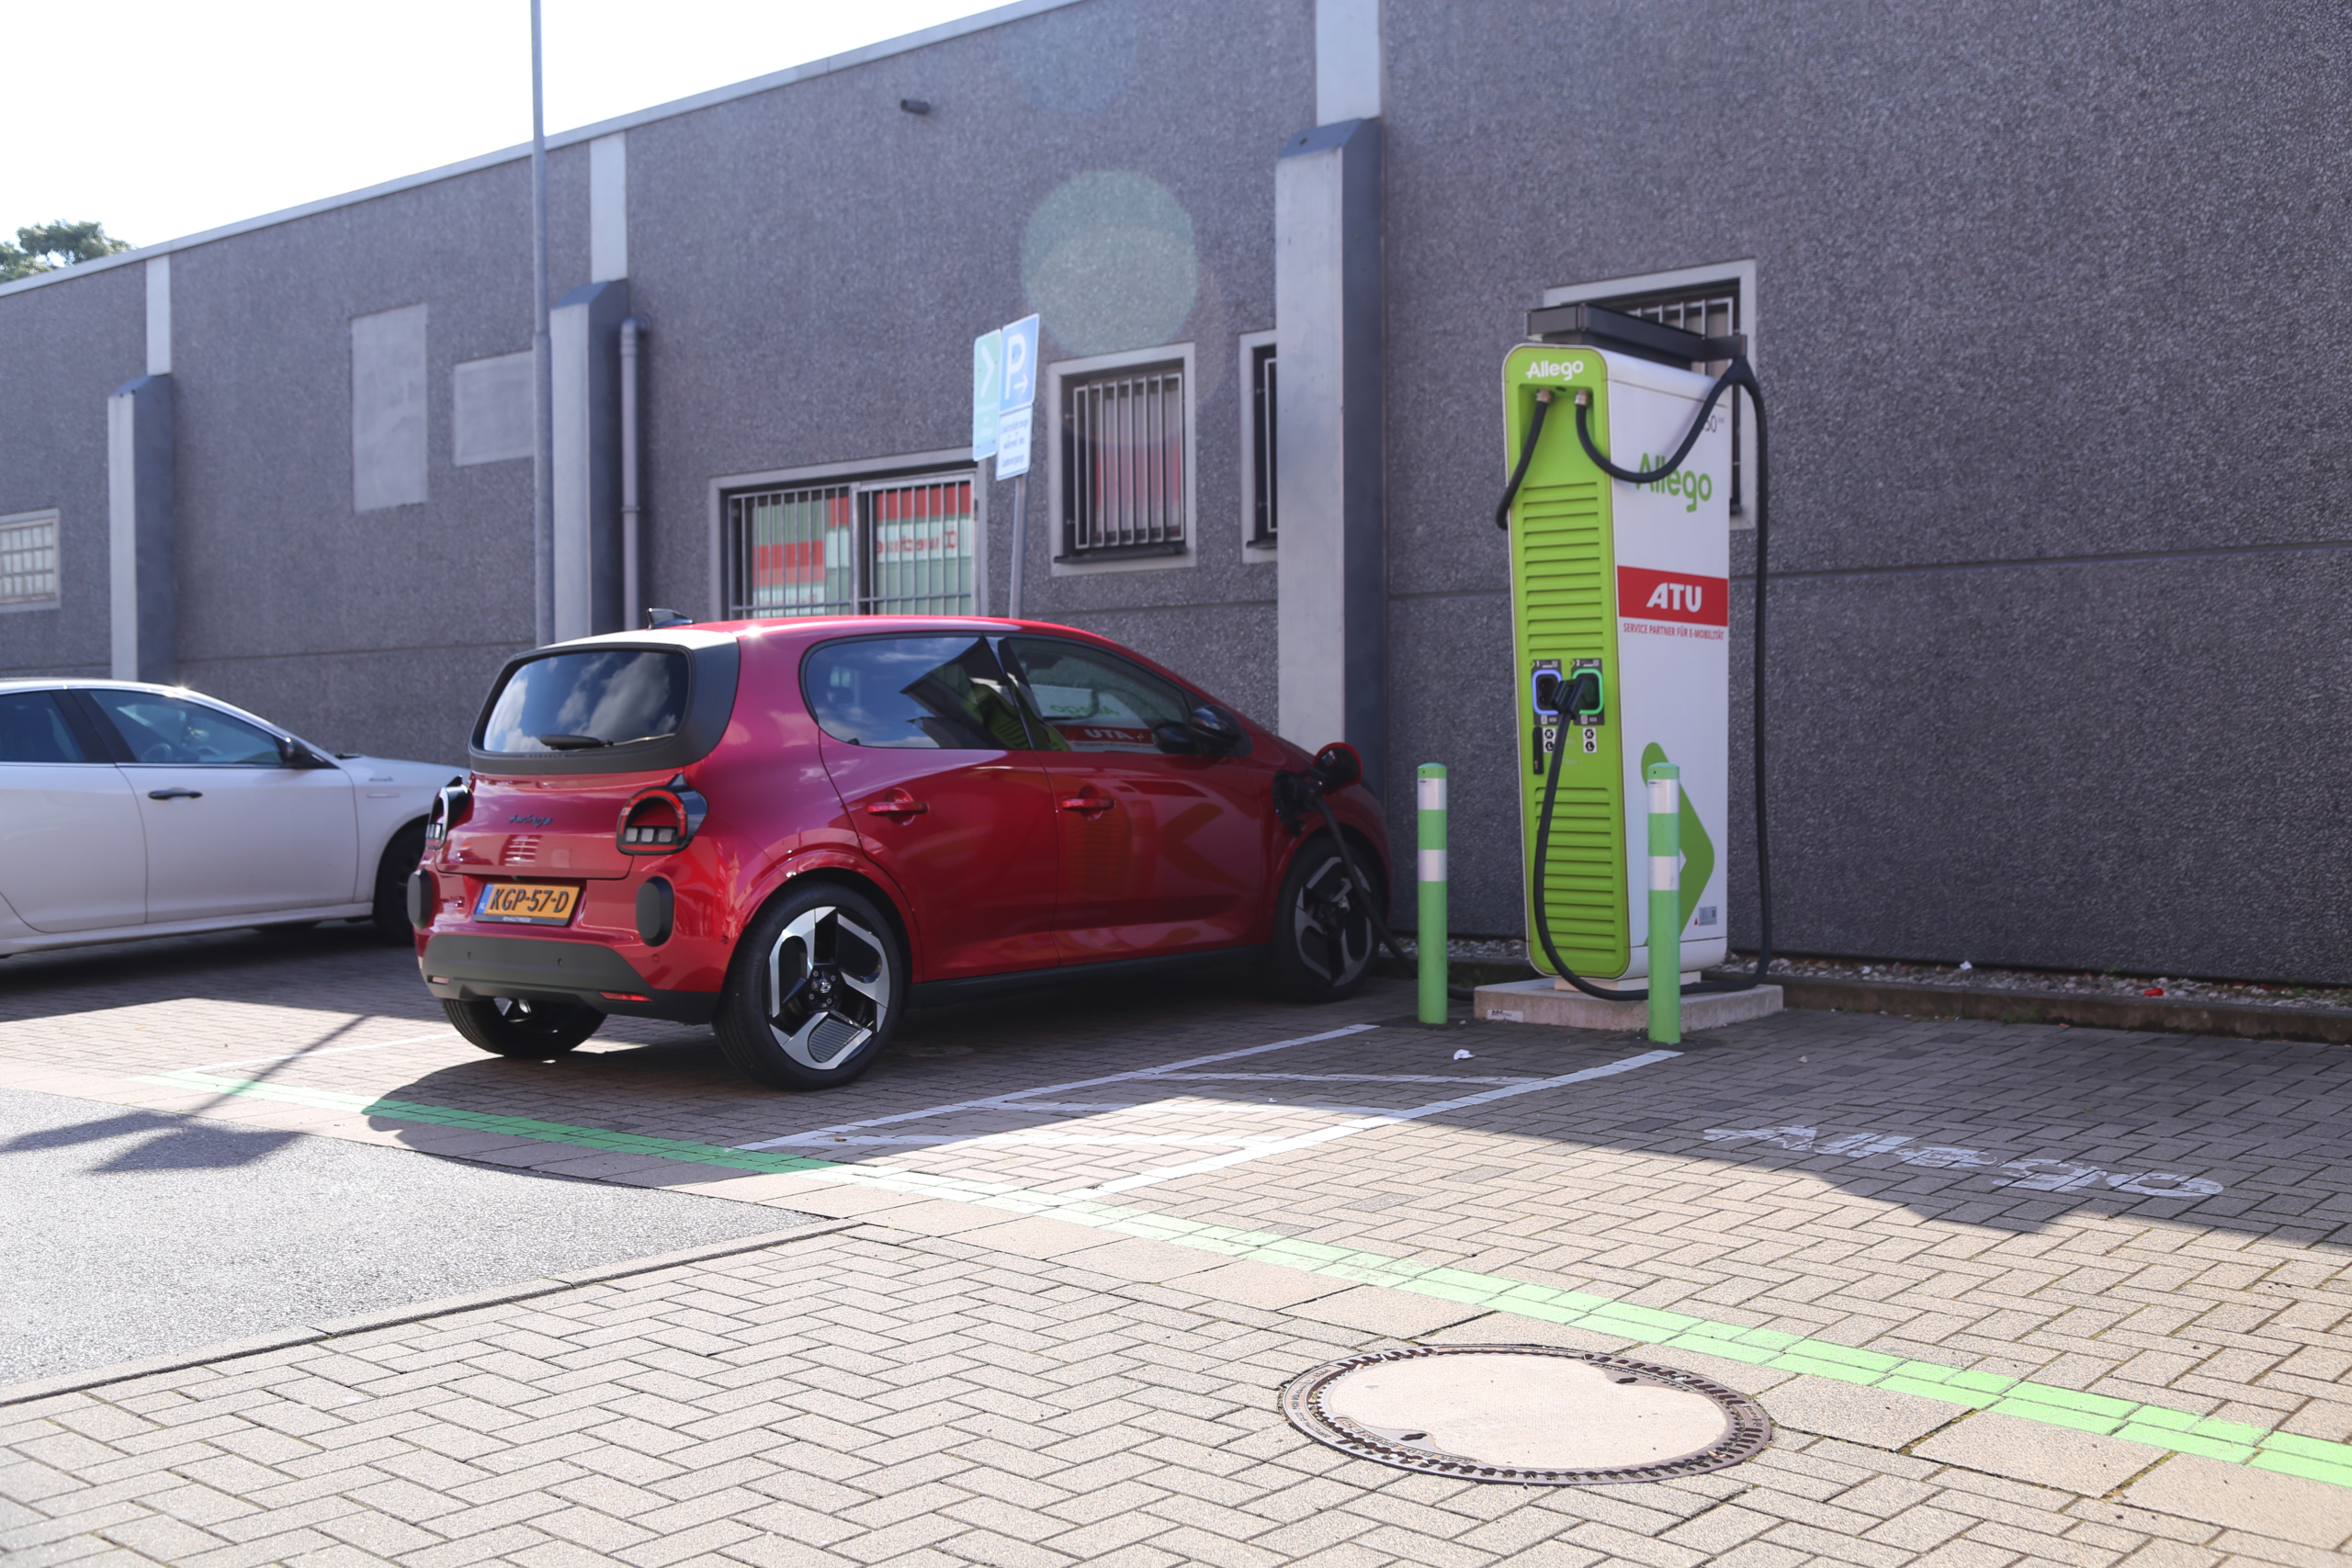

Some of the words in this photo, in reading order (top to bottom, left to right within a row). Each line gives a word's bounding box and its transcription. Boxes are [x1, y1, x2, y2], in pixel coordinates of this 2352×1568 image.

[1004, 333, 1026, 400] P
[1526, 360, 1584, 381] Allego
[1636, 452, 1713, 513] Allego
[1645, 582, 1702, 613] ATU
[1623, 623, 1647, 635] SERVICE
[1649, 625, 1675, 637] PARTNER
[1677, 626, 1689, 637] FÜR
[1690, 628, 1724, 640] E-MOBILITÄT
[490, 888, 569, 913] KGP-57-D
